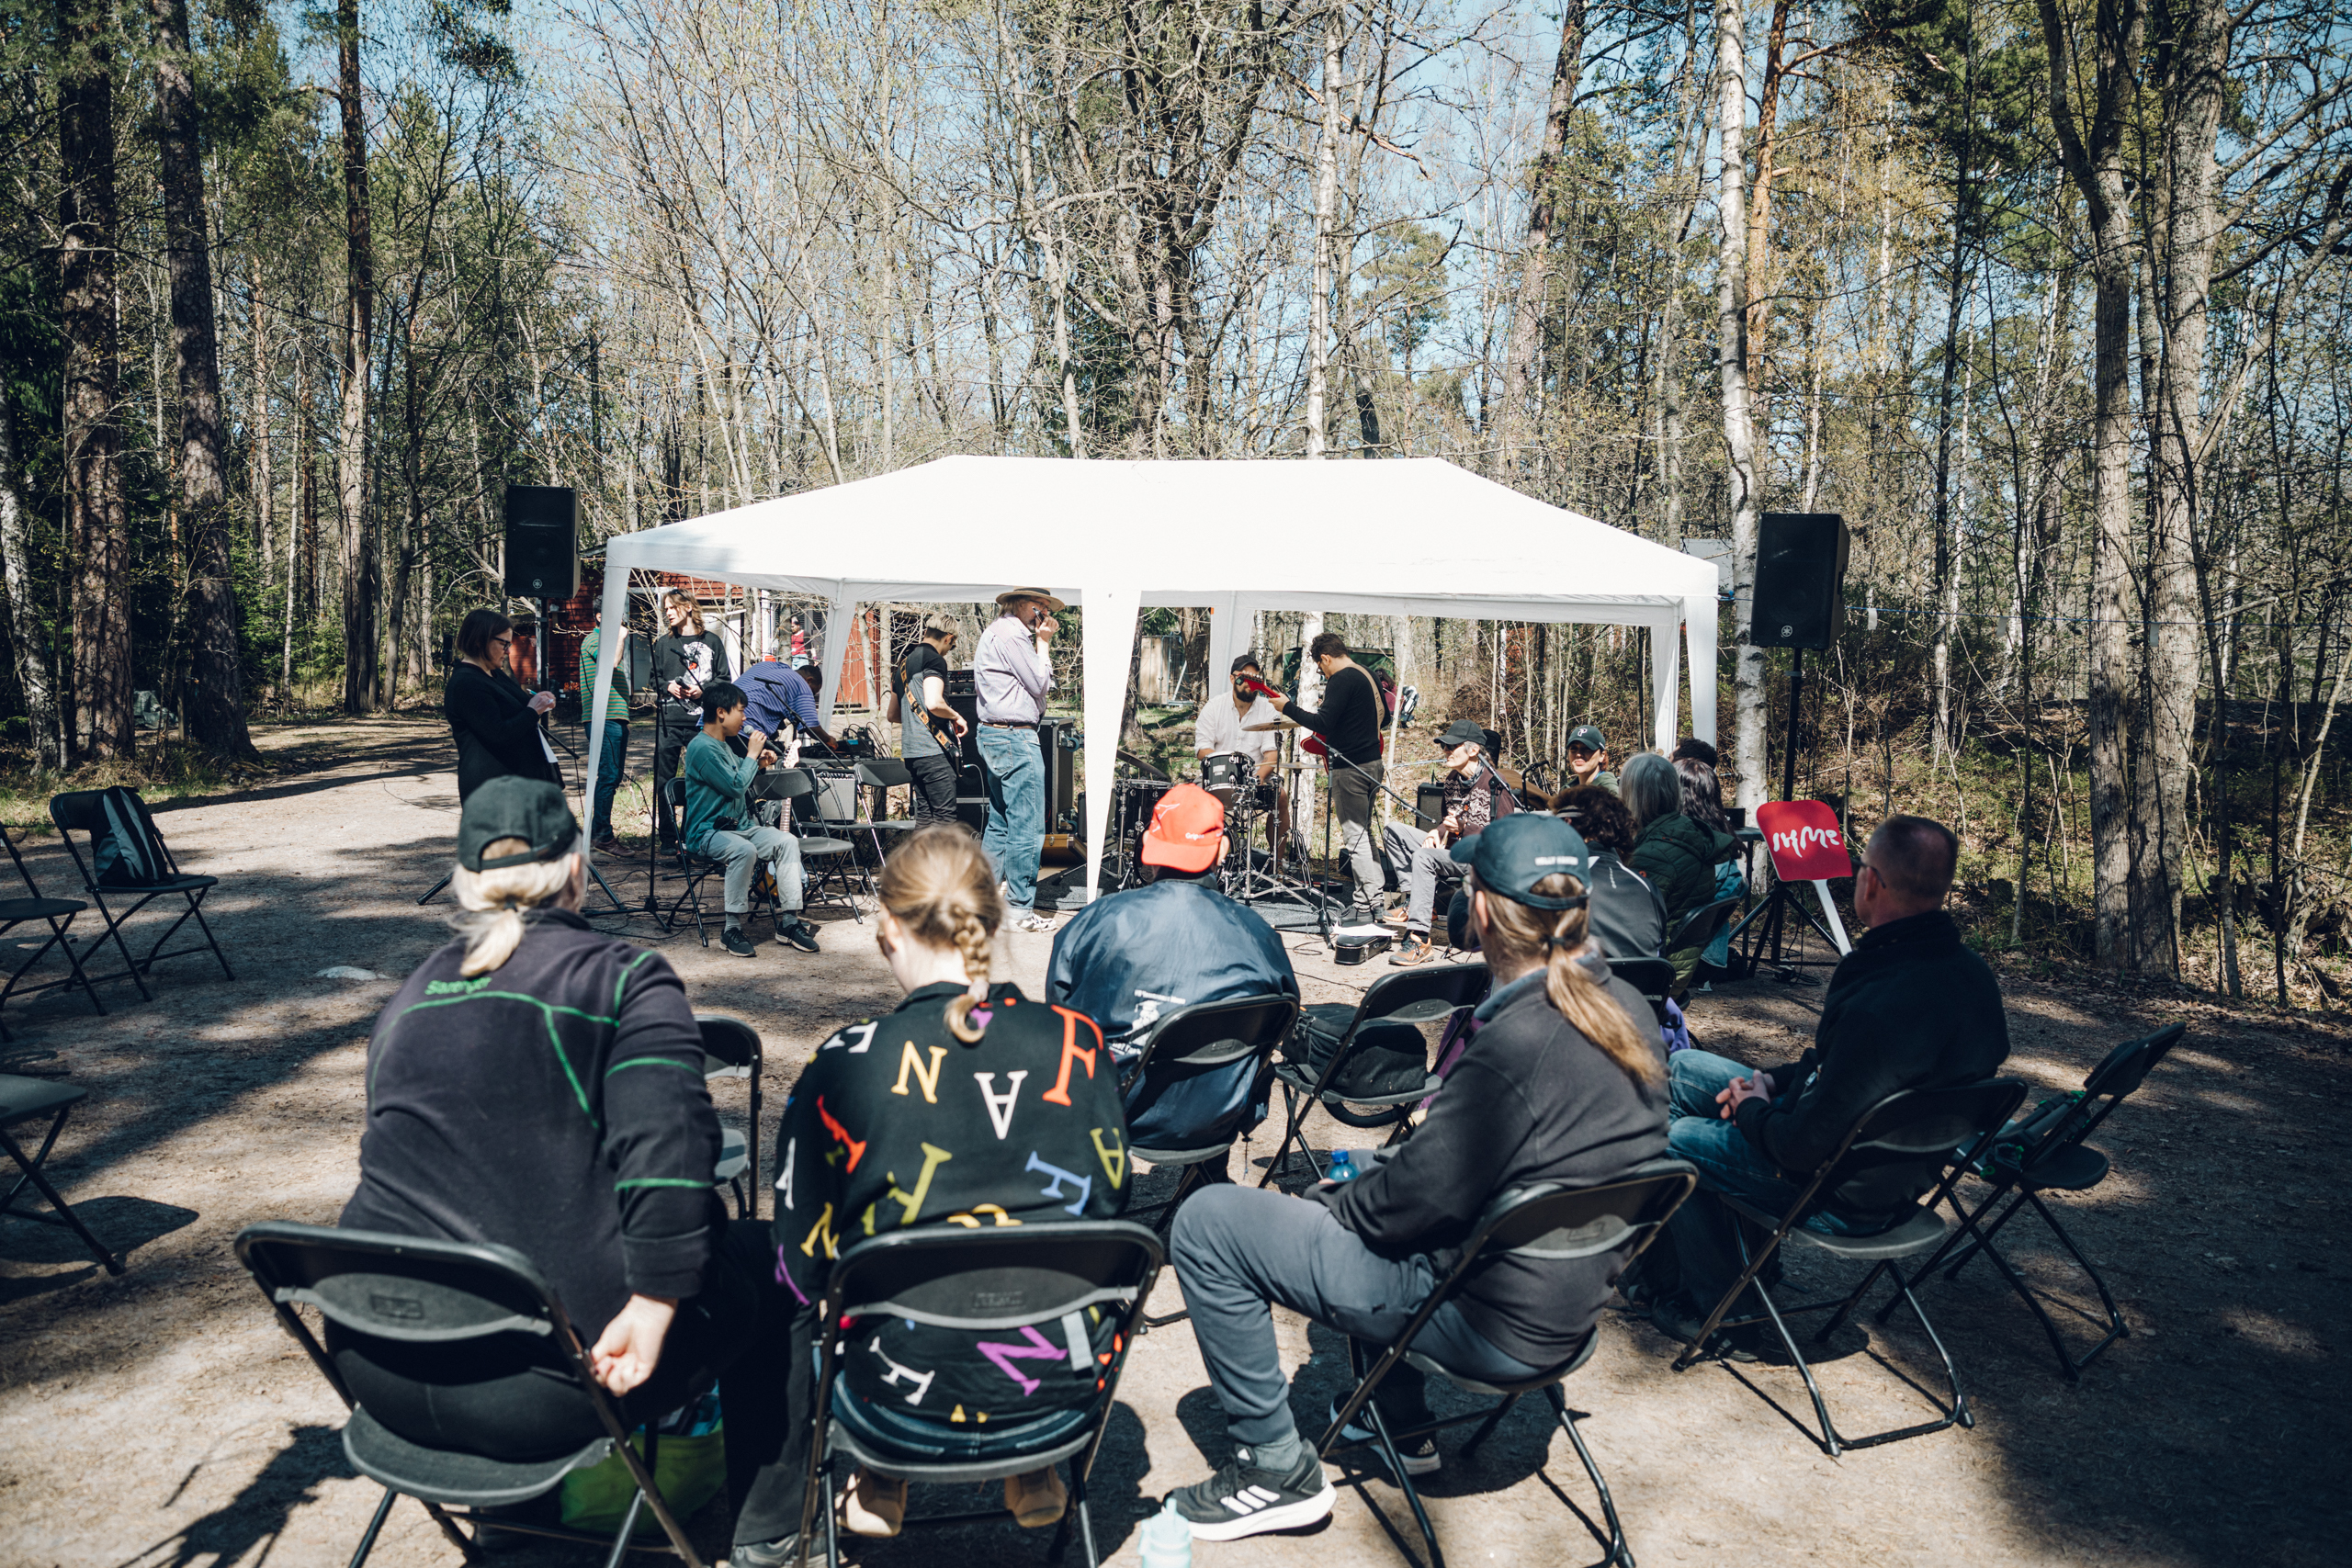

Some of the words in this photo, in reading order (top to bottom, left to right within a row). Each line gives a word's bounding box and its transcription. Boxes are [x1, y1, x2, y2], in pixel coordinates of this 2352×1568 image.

[891, 1040, 948, 1104] N
[1042, 1004, 1104, 1106] F
[974, 1070, 1028, 1139] A
